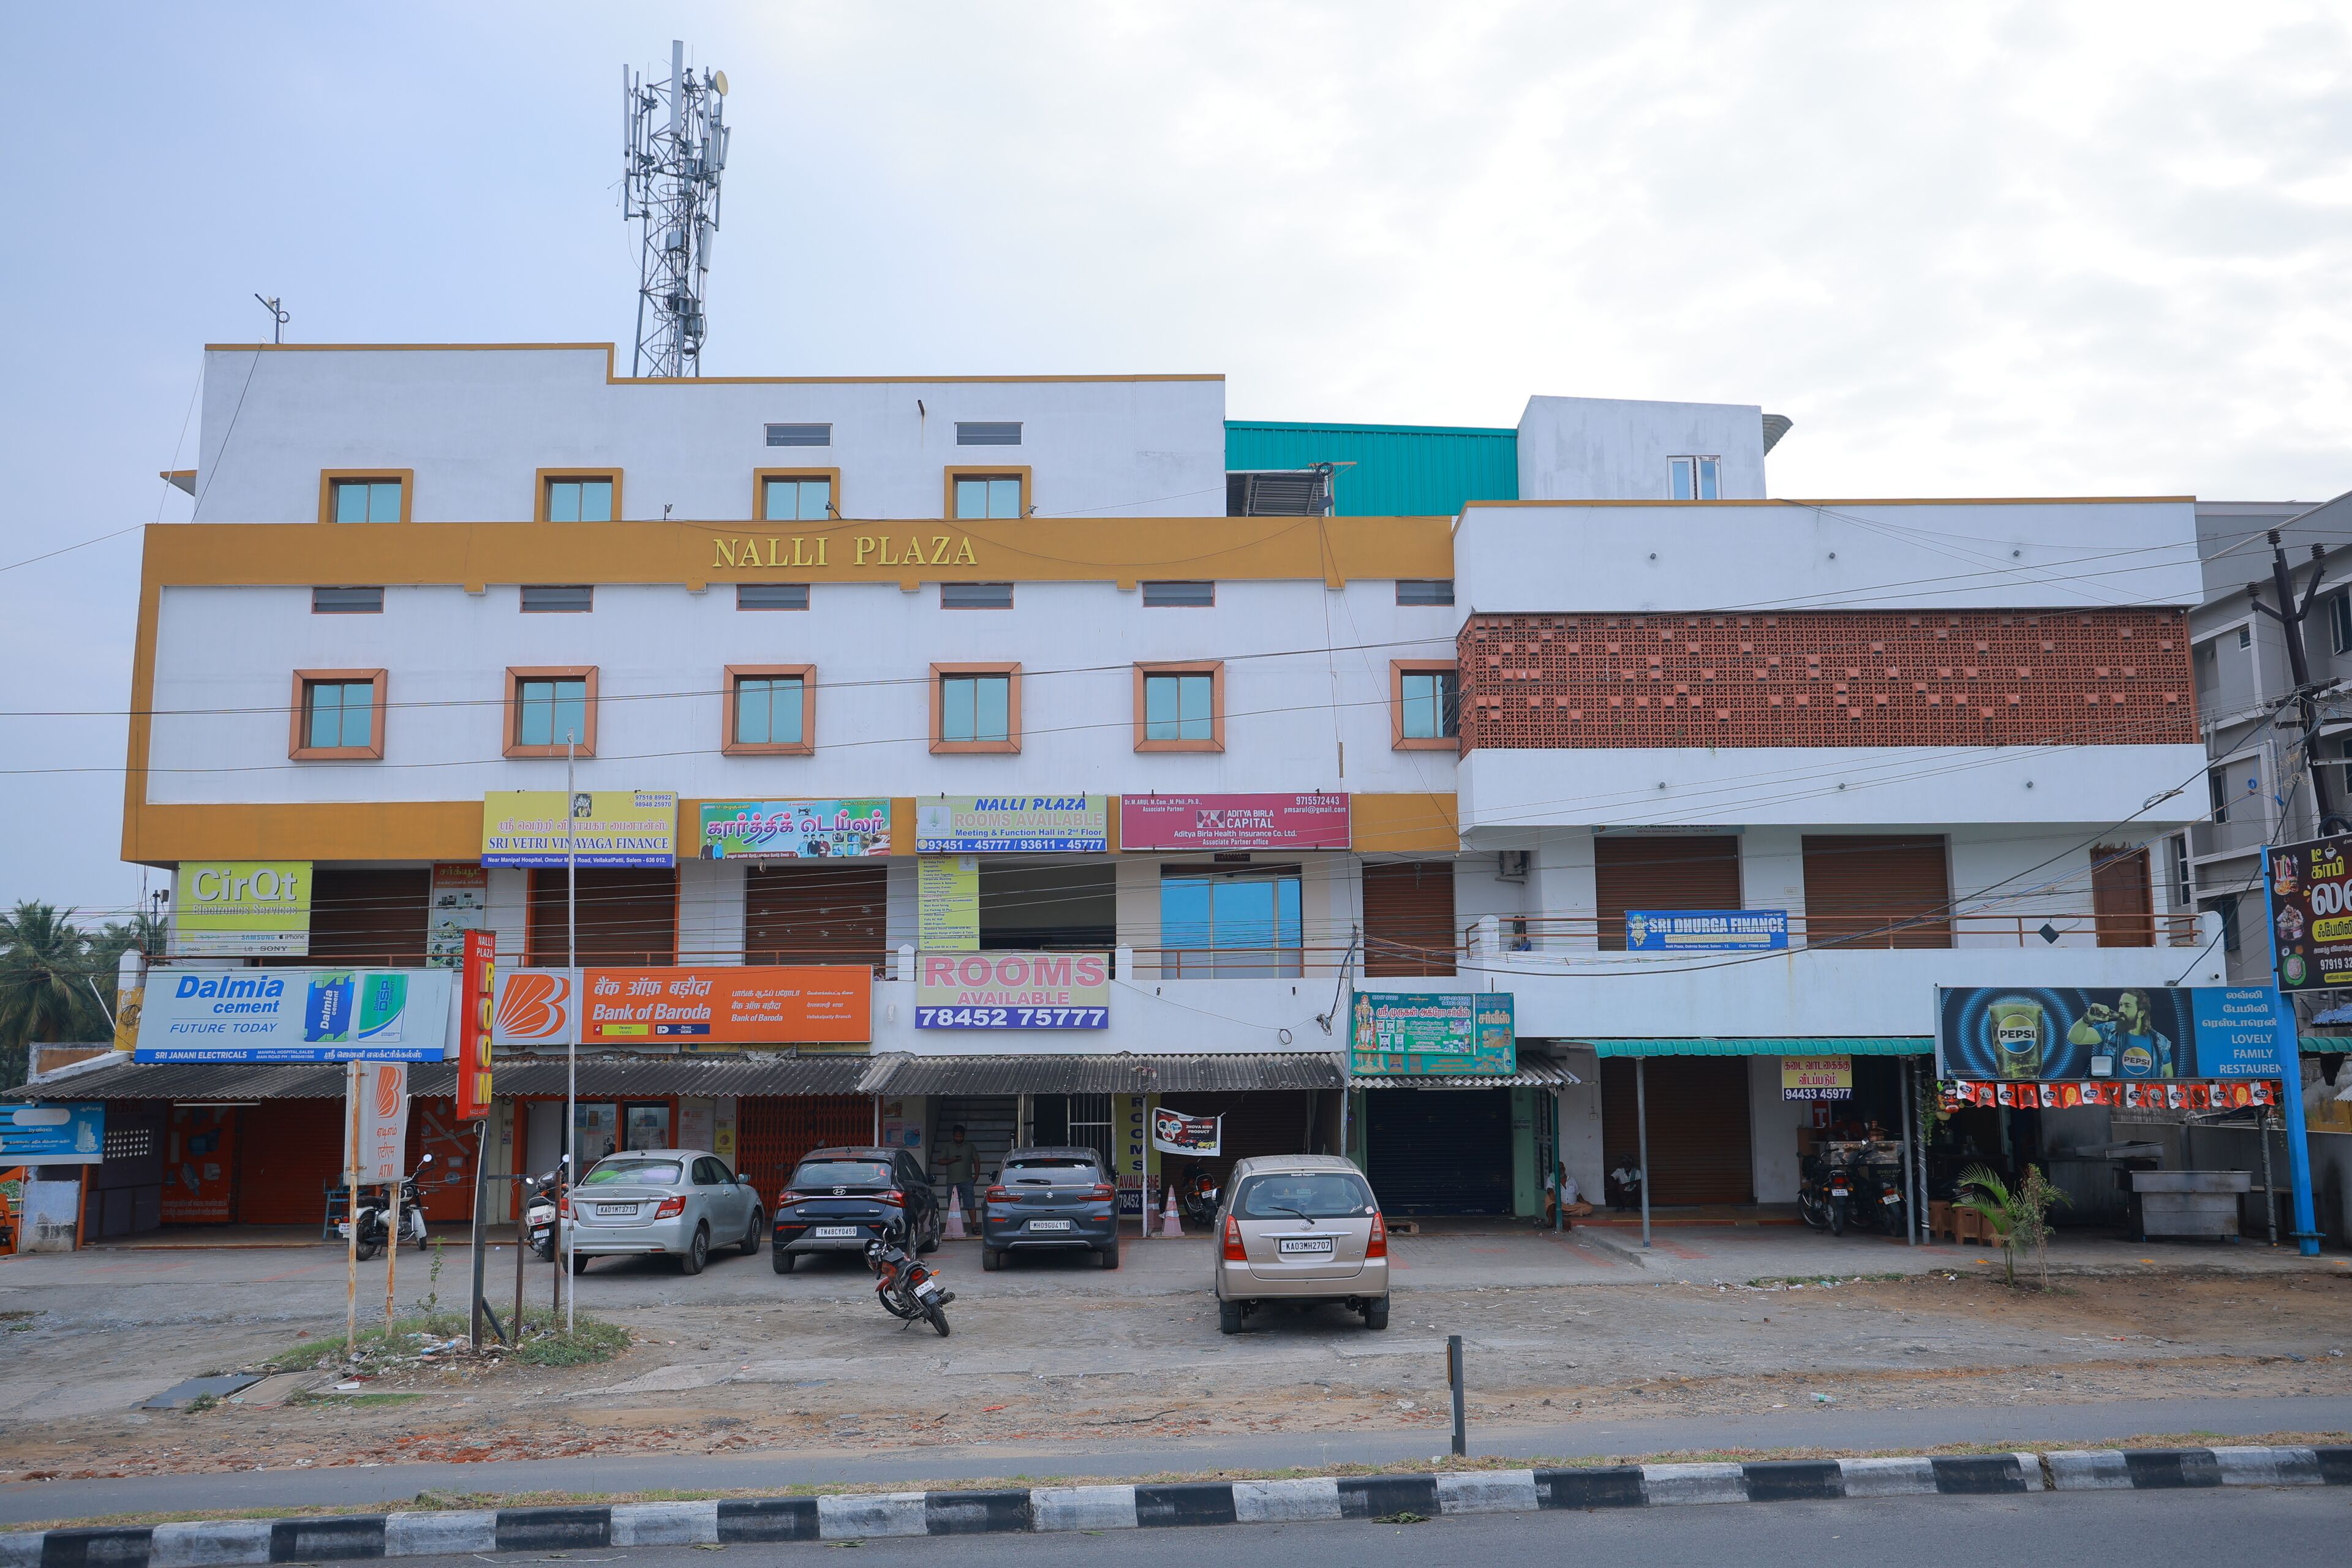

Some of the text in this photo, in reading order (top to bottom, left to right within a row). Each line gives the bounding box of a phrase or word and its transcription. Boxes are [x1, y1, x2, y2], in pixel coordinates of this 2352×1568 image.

[712, 536, 978, 567] NALLI PLAZA
[974, 798, 1087, 811] NALLI PLAZA
[1296, 796, 1340, 805] 9715572443
[499, 817, 668, 834] ஸ்ரீ வெற்றி பைனான்ஸ்
[954, 812, 1103, 827] ROOMS AVAILABLE
[1227, 818, 1274, 828] CAPITAL
[706, 809, 884, 846] கார்த்திக் டெய்லர்
[955, 829, 990, 838] Meeting
[1174, 830, 1196, 839] Aditya
[489, 838, 508, 849] SRI
[513, 838, 548, 849] VETRI
[616, 837, 668, 849] FINANCE
[928, 839, 1103, 850] 93451 45777 93611 45777
[2312, 856, 2345, 879] காபி
[192, 869, 298, 902] CirQt
[193, 903, 298, 915] Electronics Services
[1648, 918, 1785, 933] SRI DHURGA FINANCE
[477, 936, 493, 947] NALLI
[476, 948, 493, 959] PLAZA
[2320, 958, 2342, 970] 97919
[923, 956, 1106, 988] ROOMS
[175, 975, 285, 999] Dalmia
[594, 975, 714, 998] बैंक ऑफ़ बड़ौदा
[379, 981, 390, 1012] DSP
[956, 991, 1070, 1006] AVAILABLE
[2226, 989, 2264, 1001] லவ்லி
[213, 1000, 280, 1014] cement
[320, 989, 333, 1030] Dalmia
[592, 1003, 712, 1020] Bank of Baroda
[731, 1000, 782, 1011] बैंक ऑफ़ बड़ौदा
[1377, 1005, 1471, 1019] ஸ்ரீ முருகன் அக்ரோ சர்வீஸ்
[2222, 1003, 2269, 1014] பேமிலி
[919, 1009, 1106, 1027] 78452 75777
[1478, 1008, 1510, 1025] சர்வீஸ்
[169, 1022, 278, 1033] FUTURE TODAY
[1999, 1029, 2037, 1039] PEPSI
[2231, 1034, 2272, 1044] LOVELY
[323, 1049, 335, 1059] ஸ்ரீ
[2124, 1055, 2151, 1066] PEPSI
[2234, 1049, 2274, 1058] FAMILY
[1784, 1057, 1851, 1072] கடை வாடகைக்கு
[1798, 1072, 1838, 1087] விடப்படும்
[1785, 1088, 1852, 1099] 94433 45977
[377, 1142, 396, 1161] एटीएम
[378, 1163, 394, 1178] ATM
[1119, 1194, 1139, 1208] 78452
[1286, 1242, 1330, 1251] KA03MH2707
